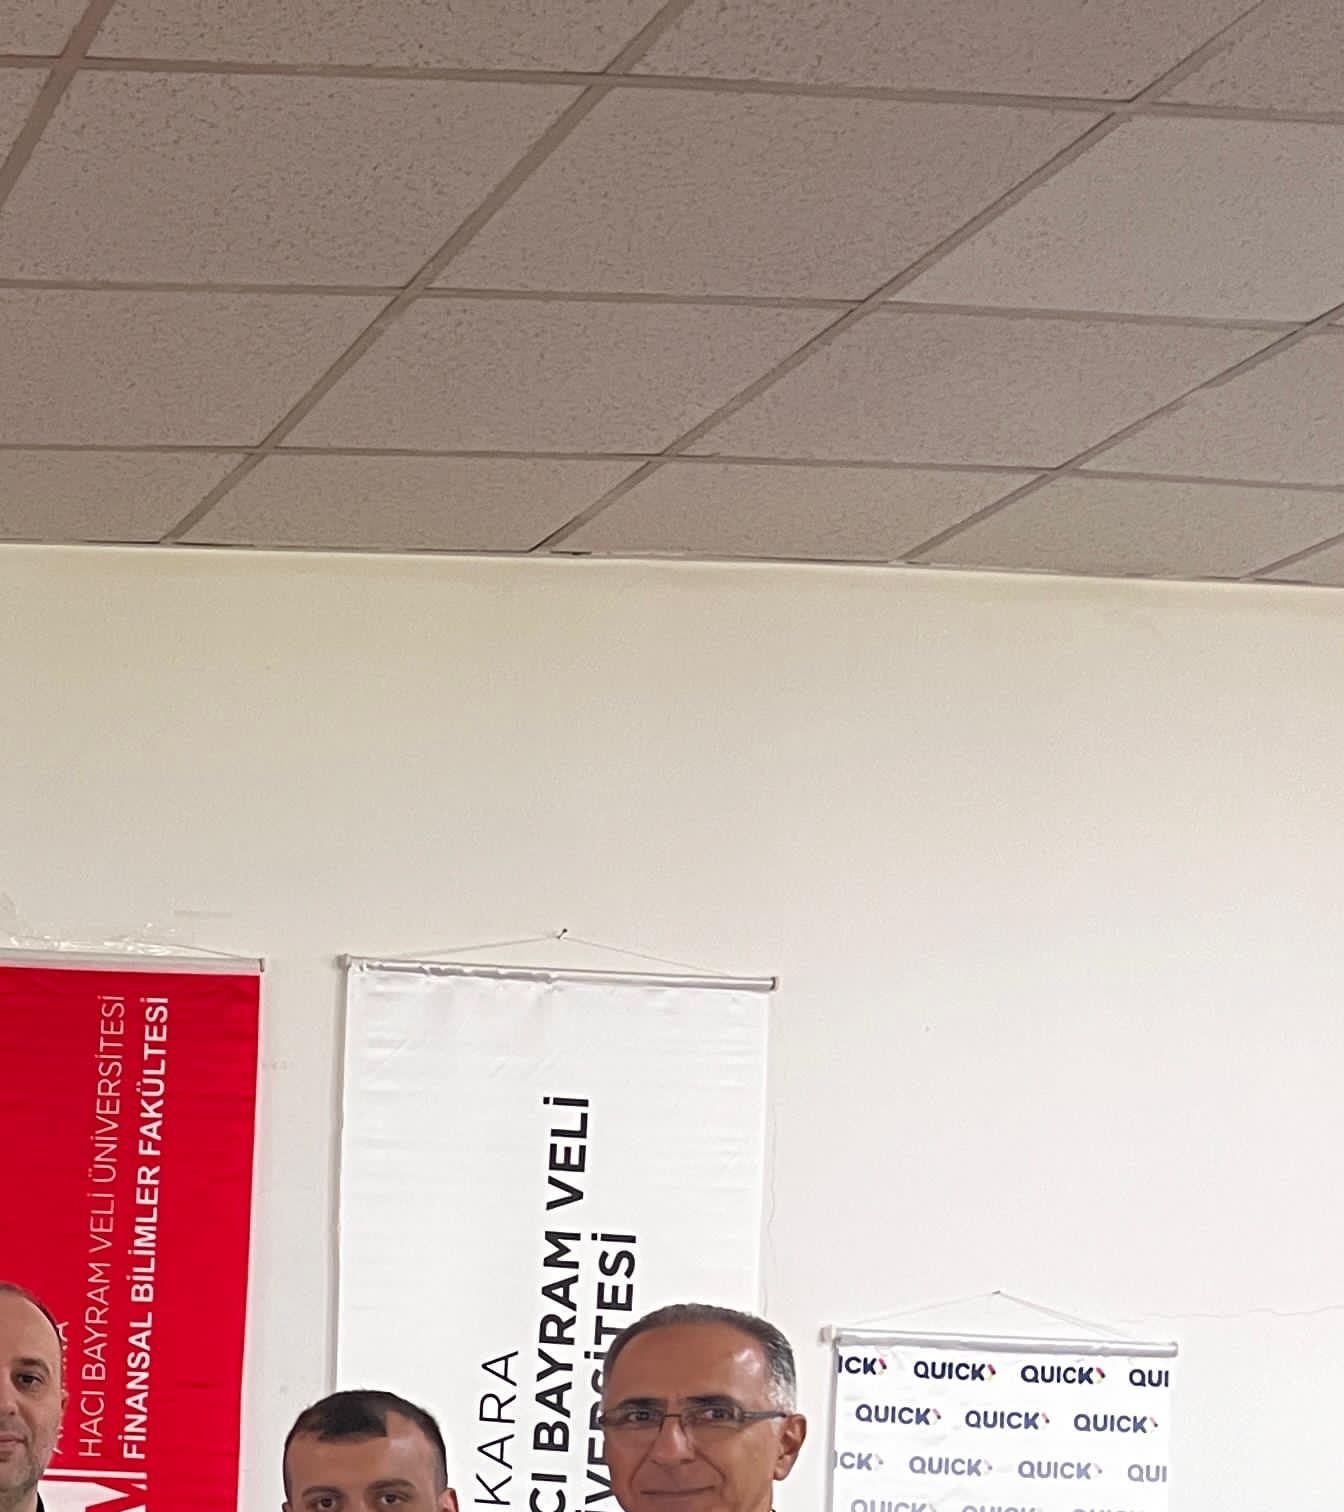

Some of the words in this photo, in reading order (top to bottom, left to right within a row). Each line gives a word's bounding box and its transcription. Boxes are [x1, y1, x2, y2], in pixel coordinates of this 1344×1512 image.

[87, 995, 125, 1183] ÜNİVERSİTESİ
[135, 997, 169, 1156] FAKÜLTESİ
[543, 1096, 589, 1211] VELİ
[86, 1192, 115, 1253] VELİ
[125, 1165, 160, 1302] BİLİMLER
[81, 1262, 111, 1380] BAYRAM
[533, 1230, 581, 1452] BAYRAM
[913, 1360, 986, 1382] QUICK
[1020, 1365, 1094, 1385] QUICK
[78, 1390, 104, 1456] HACI
[118, 1311, 152, 1459] FİNANSAL
[855, 1404, 931, 1425] QUICK
[965, 1410, 1040, 1430] QUICK
[1073, 1413, 1148, 1433] QUICK
[908, 1456, 983, 1477] QUICK
[1018, 1460, 1092, 1480] QUICK
